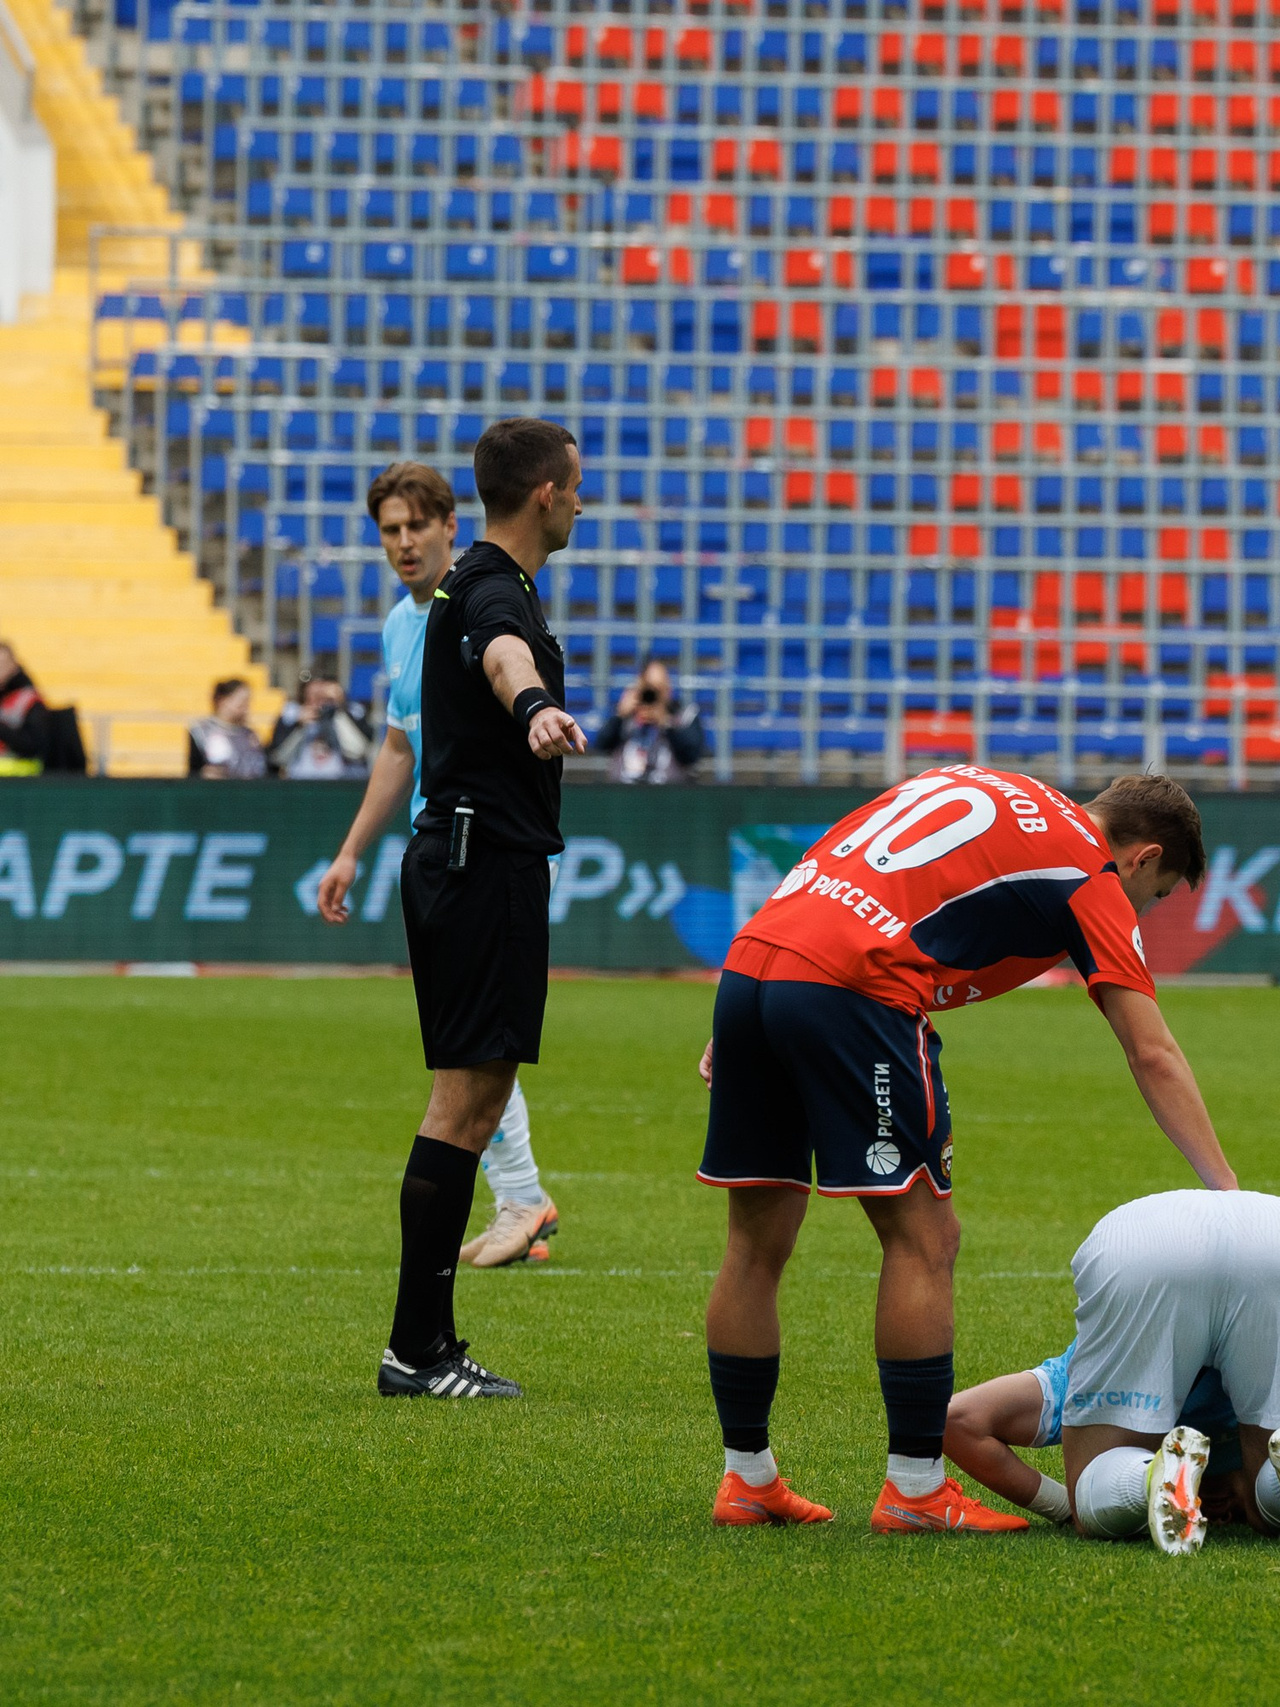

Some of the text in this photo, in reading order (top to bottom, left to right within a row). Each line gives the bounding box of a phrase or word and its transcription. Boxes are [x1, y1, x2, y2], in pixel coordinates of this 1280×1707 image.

[830, 775, 997, 873] 10
[807, 873, 907, 939] РОССЕТИ
[874, 1063, 893, 1137] РОССЕТИ
[1071, 1390, 1161, 1412] БЕТСИТИ
